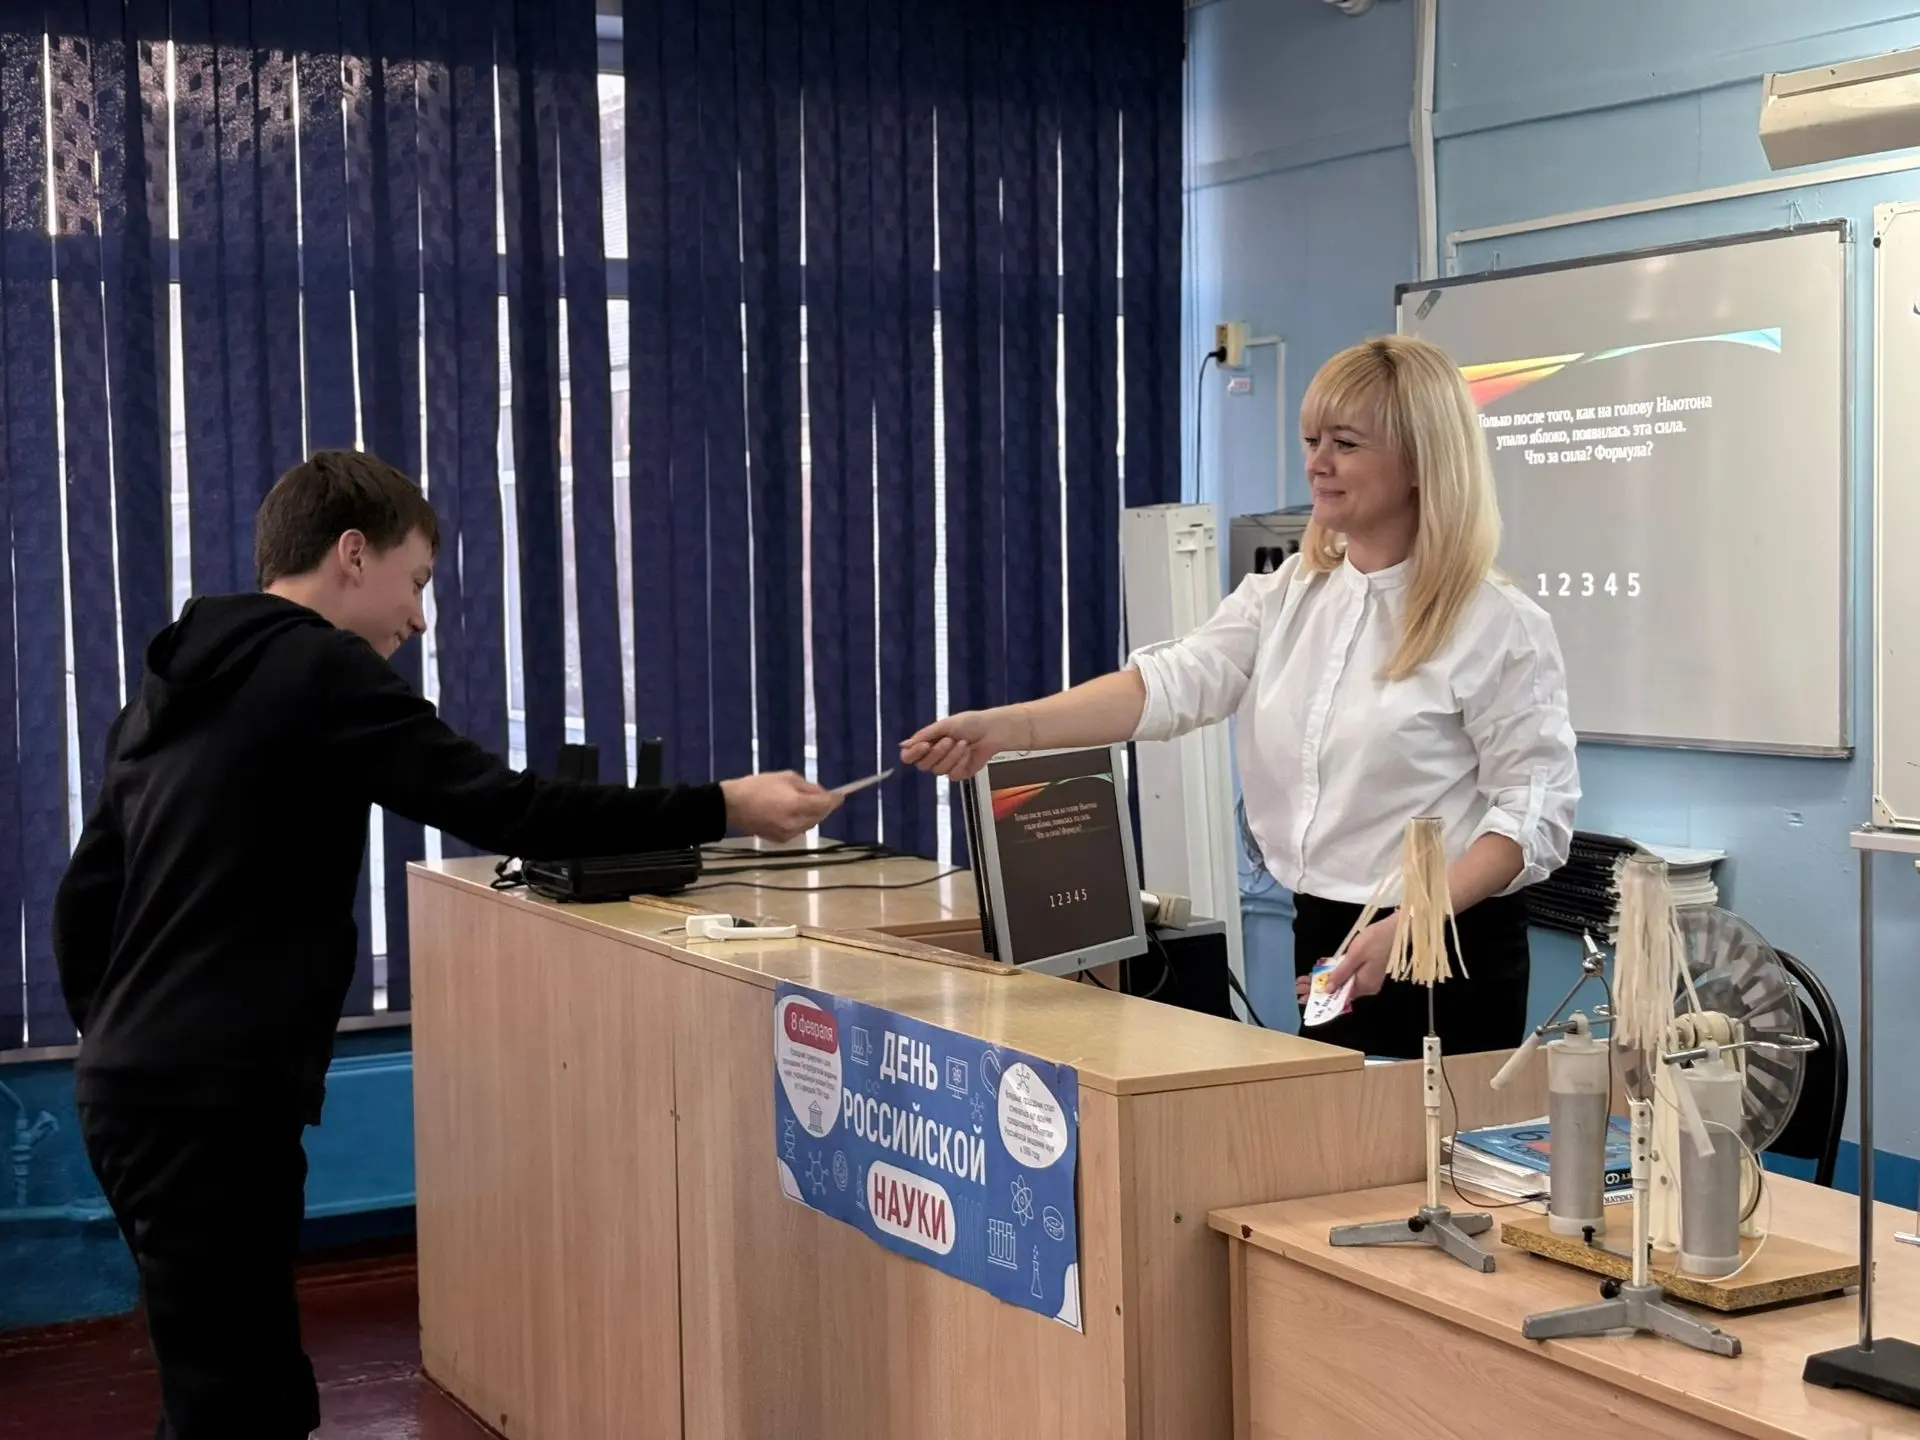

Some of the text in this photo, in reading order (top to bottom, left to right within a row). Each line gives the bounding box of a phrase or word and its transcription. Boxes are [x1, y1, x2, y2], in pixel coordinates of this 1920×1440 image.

[1477, 395, 1713, 428] Только после того, как на голову Ньютона
[1496, 420, 1687, 451] упало яблоко, появилась эта сила.
[1524, 440, 1654, 465] Что за сила? Формула?
[791, 1011, 834, 1043] 8 февраля
[879, 1030, 939, 1091] ДЕНЬ
[843, 1087, 986, 1186] РОССИЙСКОЙ
[873, 1172, 948, 1245] НАУКИ
